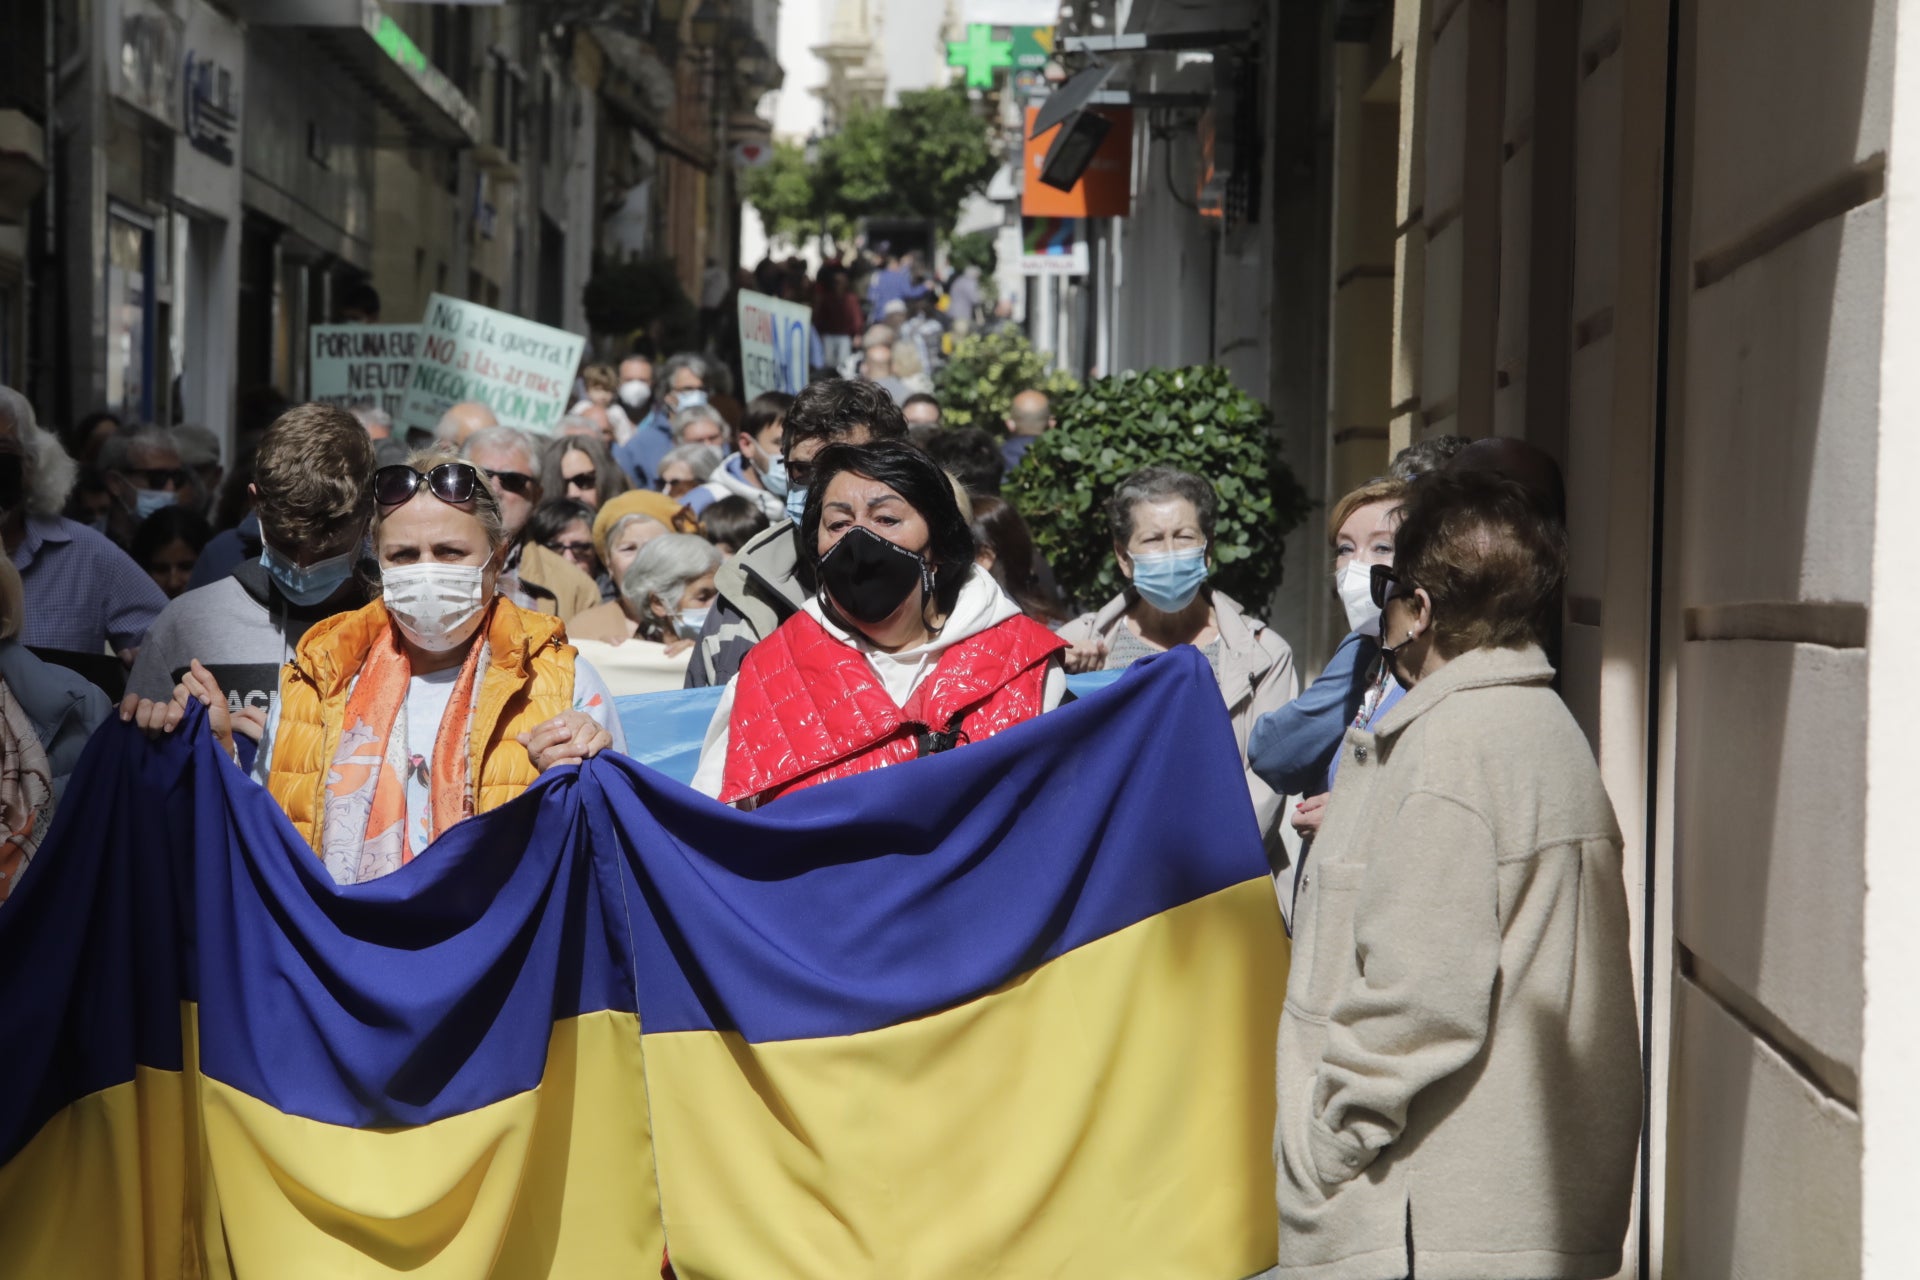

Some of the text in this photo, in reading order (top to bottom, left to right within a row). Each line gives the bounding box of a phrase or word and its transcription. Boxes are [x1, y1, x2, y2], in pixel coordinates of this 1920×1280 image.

[316, 333, 351, 358] POR
[354, 333, 387, 358] UNA
[433, 303, 464, 333] NO
[465, 321, 479, 339] a
[481, 318, 496, 346] la
[423, 334, 562, 399] NO a las armas
[771, 314, 806, 395] NO
